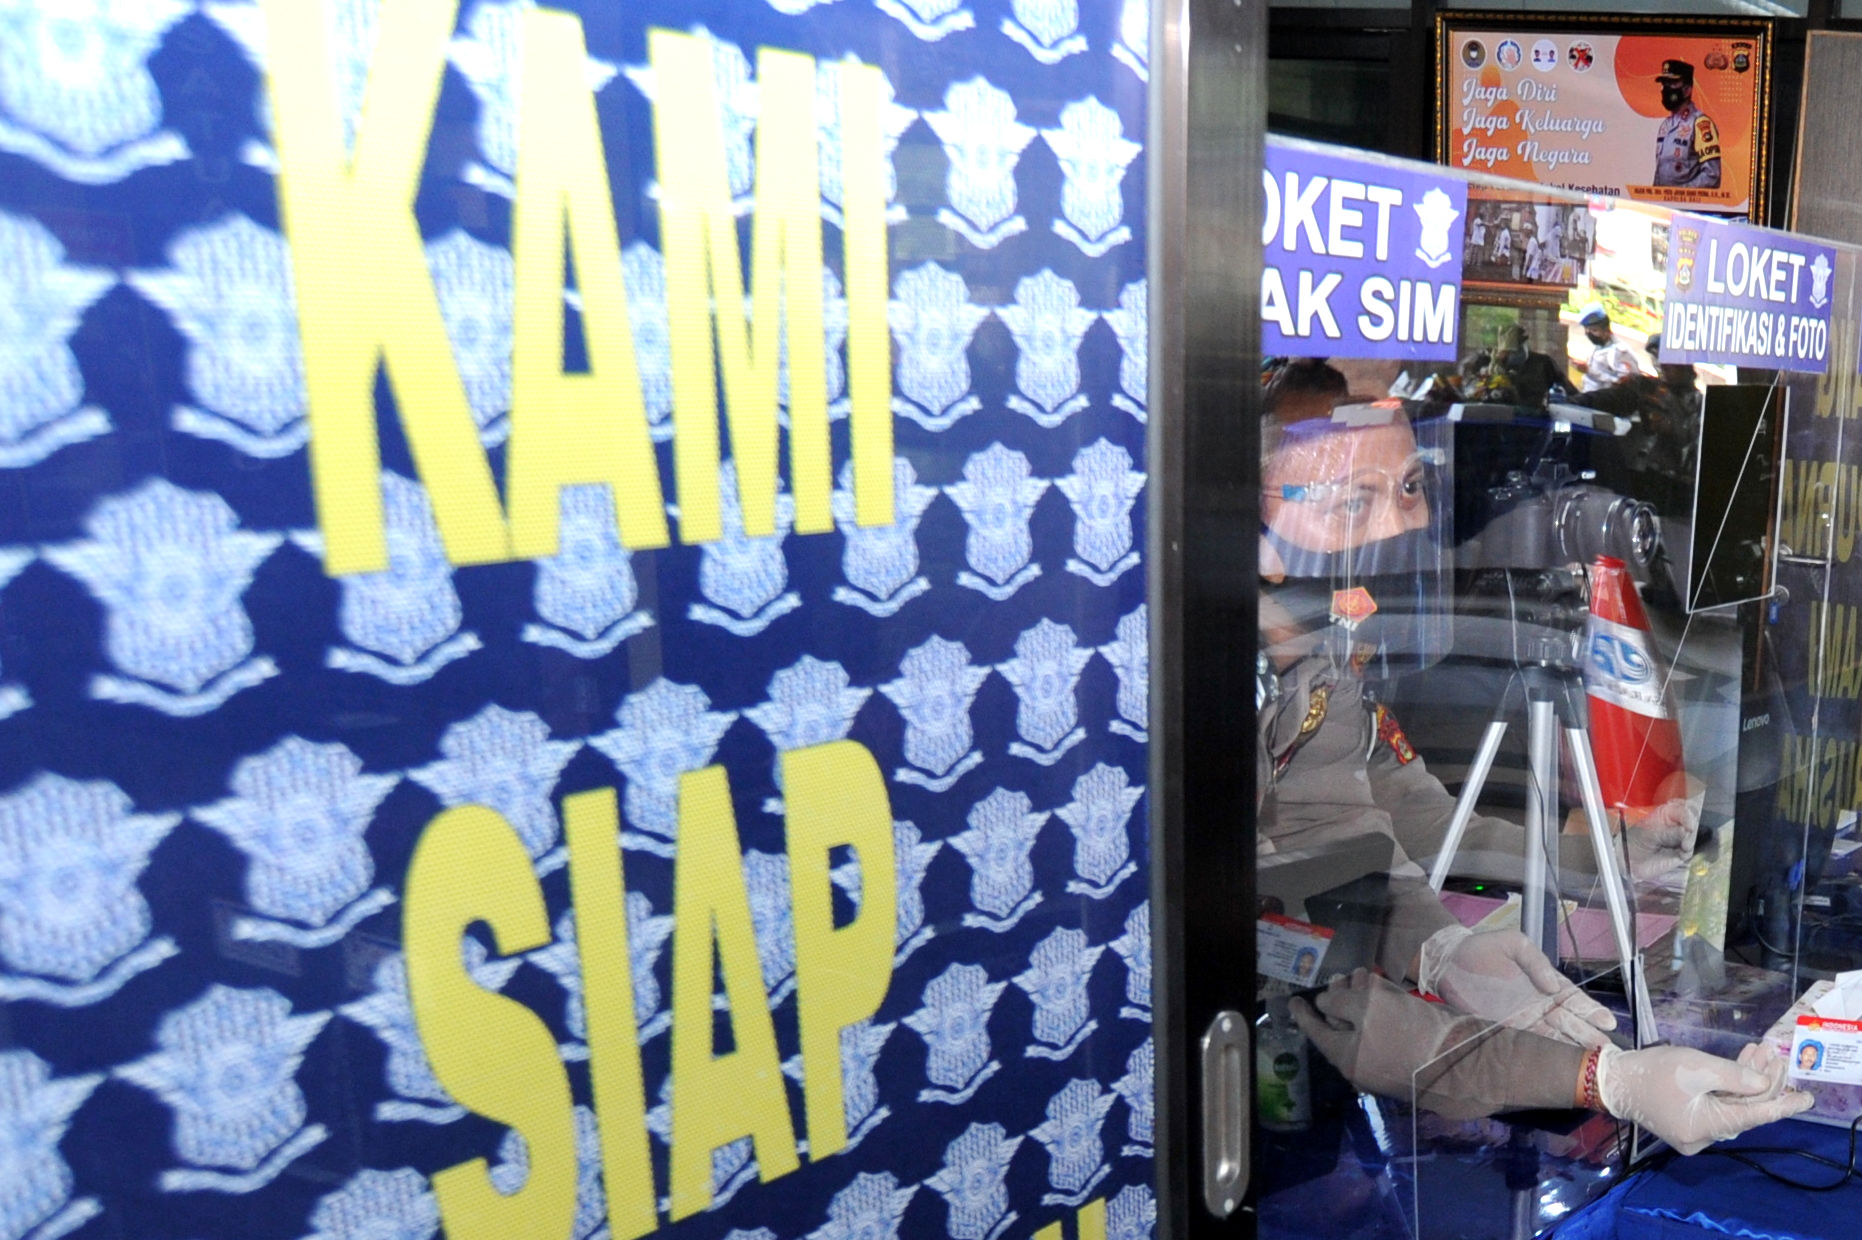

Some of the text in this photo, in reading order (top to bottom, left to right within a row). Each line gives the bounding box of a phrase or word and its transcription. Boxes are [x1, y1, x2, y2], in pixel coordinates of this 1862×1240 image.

[1462, 78, 1558, 106] Jaga Diri
[1462, 107, 1605, 141] Jaga Keluarga
[1462, 138, 1591, 170] Jaga Negara
[261, 0, 898, 577] KAMI
[1706, 238, 1807, 305] LOKET
[1357, 275, 1456, 344] SIM
[1665, 301, 1828, 362] IDENTIFIKASI & FOTO
[1743, 713, 1770, 732] Lenovo
